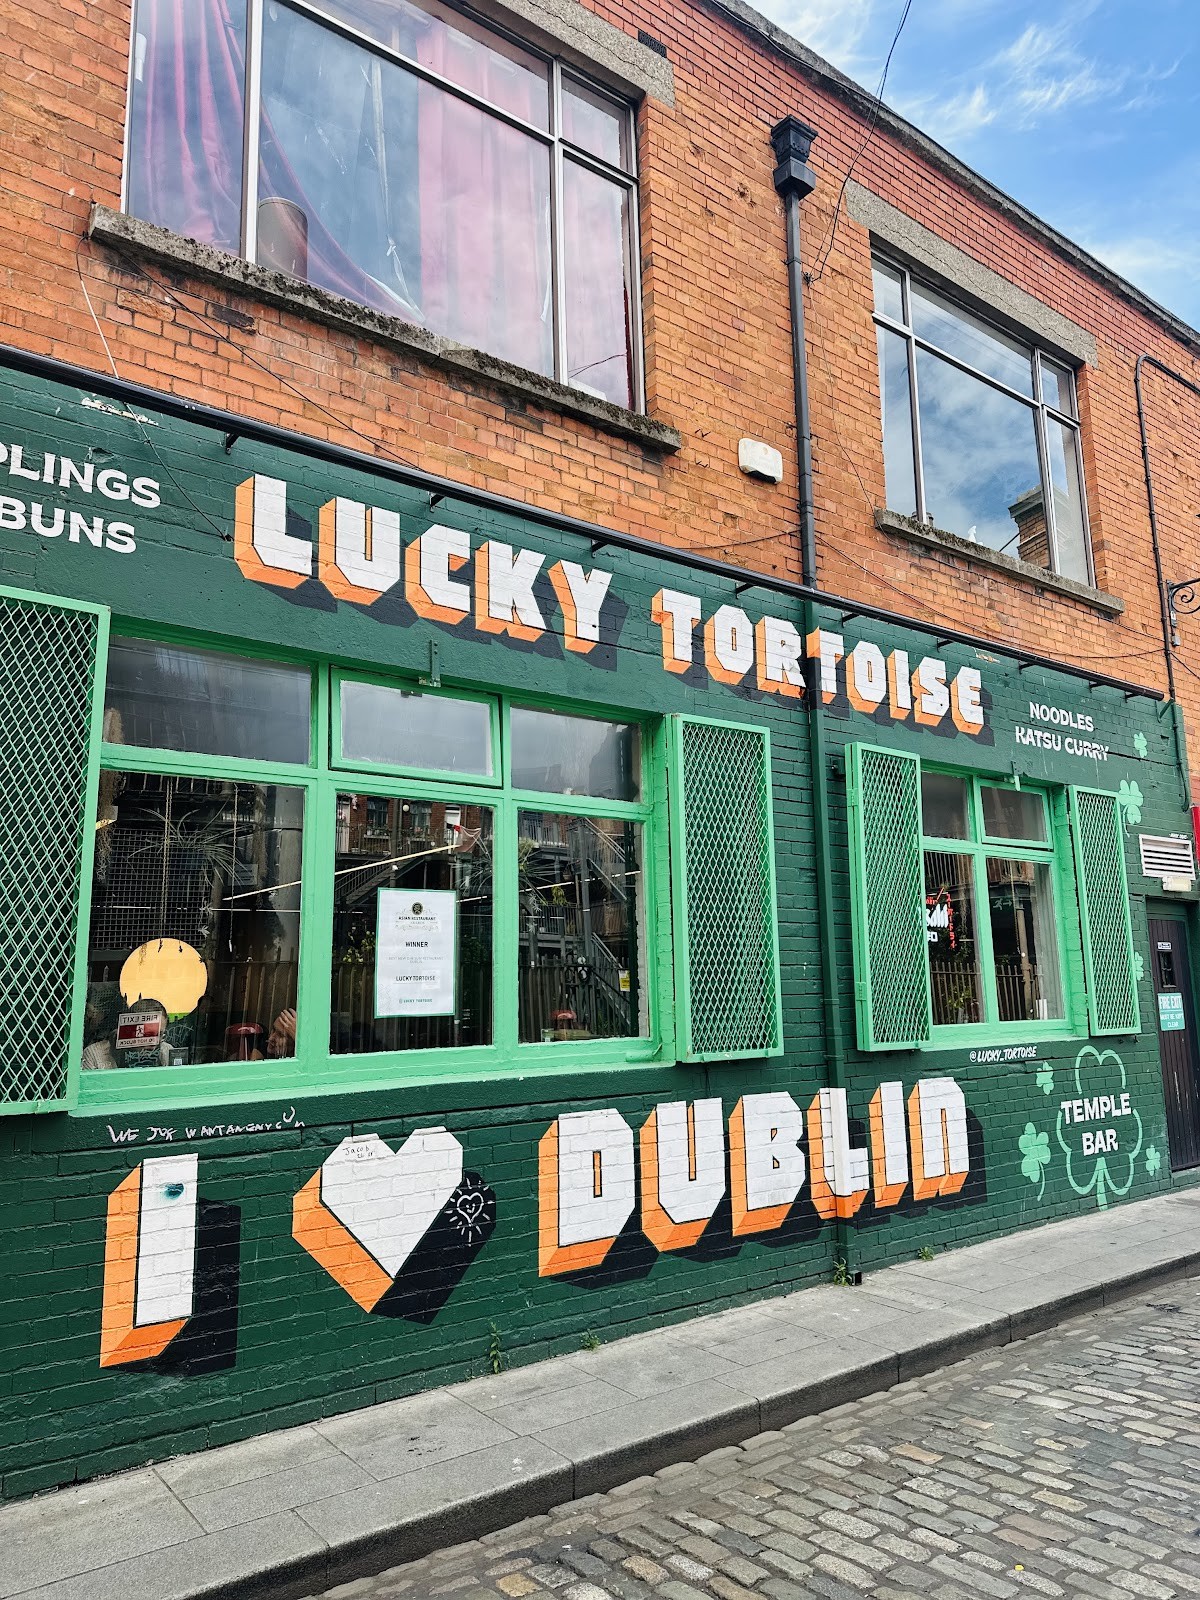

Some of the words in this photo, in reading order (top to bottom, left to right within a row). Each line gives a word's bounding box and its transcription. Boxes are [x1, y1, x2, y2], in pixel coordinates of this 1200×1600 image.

[0, 494, 137, 554] BUNS
[234, 473, 613, 654] LUCKY
[651, 587, 985, 736] TORTOISE
[1029, 701, 1094, 732] NOODLES
[1015, 725, 1061, 752] KATSU
[1064, 737, 1109, 761] CURRY
[1158, 995, 1170, 1010] FIRE
[1170, 995, 1183, 1009] EXIT
[969, 1045, 1037, 1063] @LUCKY_TORTOISE
[1060, 1092, 1132, 1125] TEMPLE
[106, 1124, 140, 1144] WE
[1082, 1128, 1119, 1156] BAR
[342, 1145, 370, 1156] Jacob
[538, 1076, 970, 1278] DUBLIN
